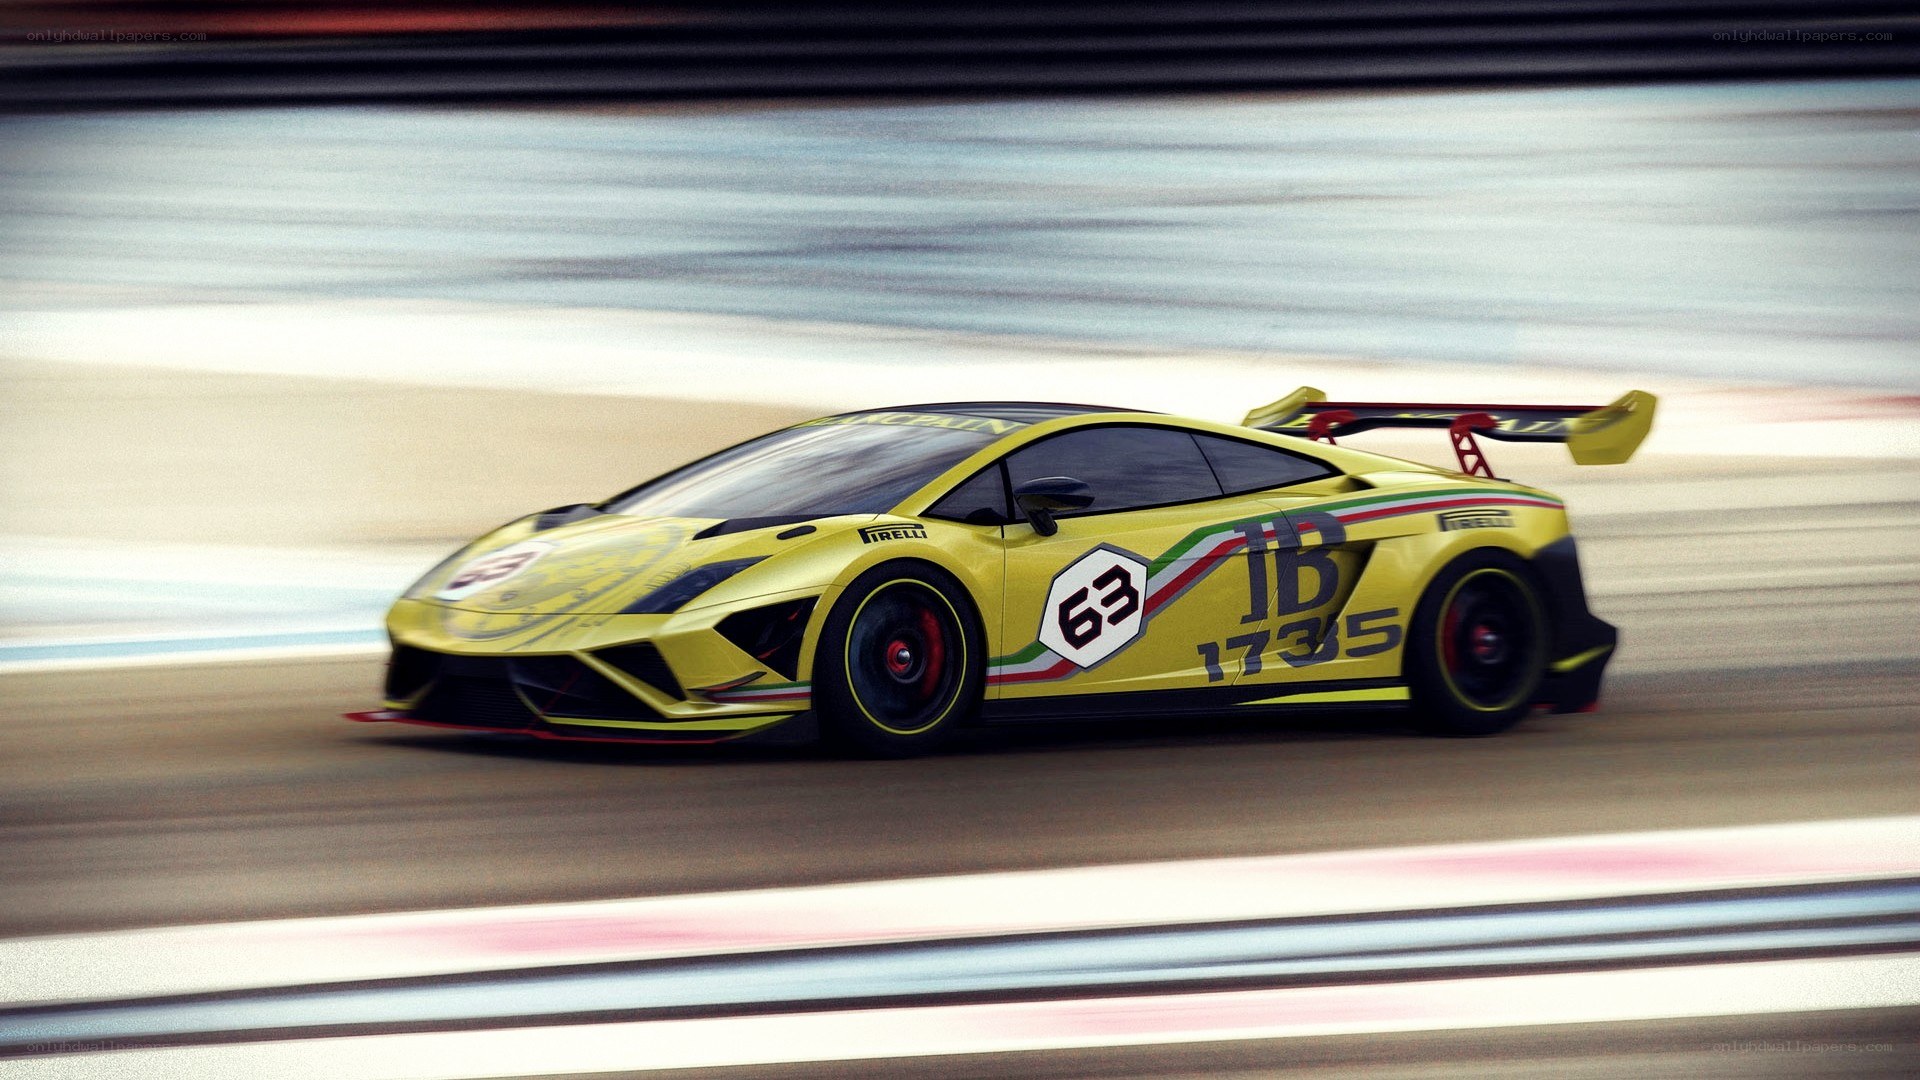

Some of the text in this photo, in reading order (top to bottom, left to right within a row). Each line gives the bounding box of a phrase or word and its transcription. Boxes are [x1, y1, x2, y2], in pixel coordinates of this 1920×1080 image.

[857, 523, 928, 545] PIRELLI
[1058, 564, 1139, 650] 63
[1197, 607, 1403, 683] 1735
